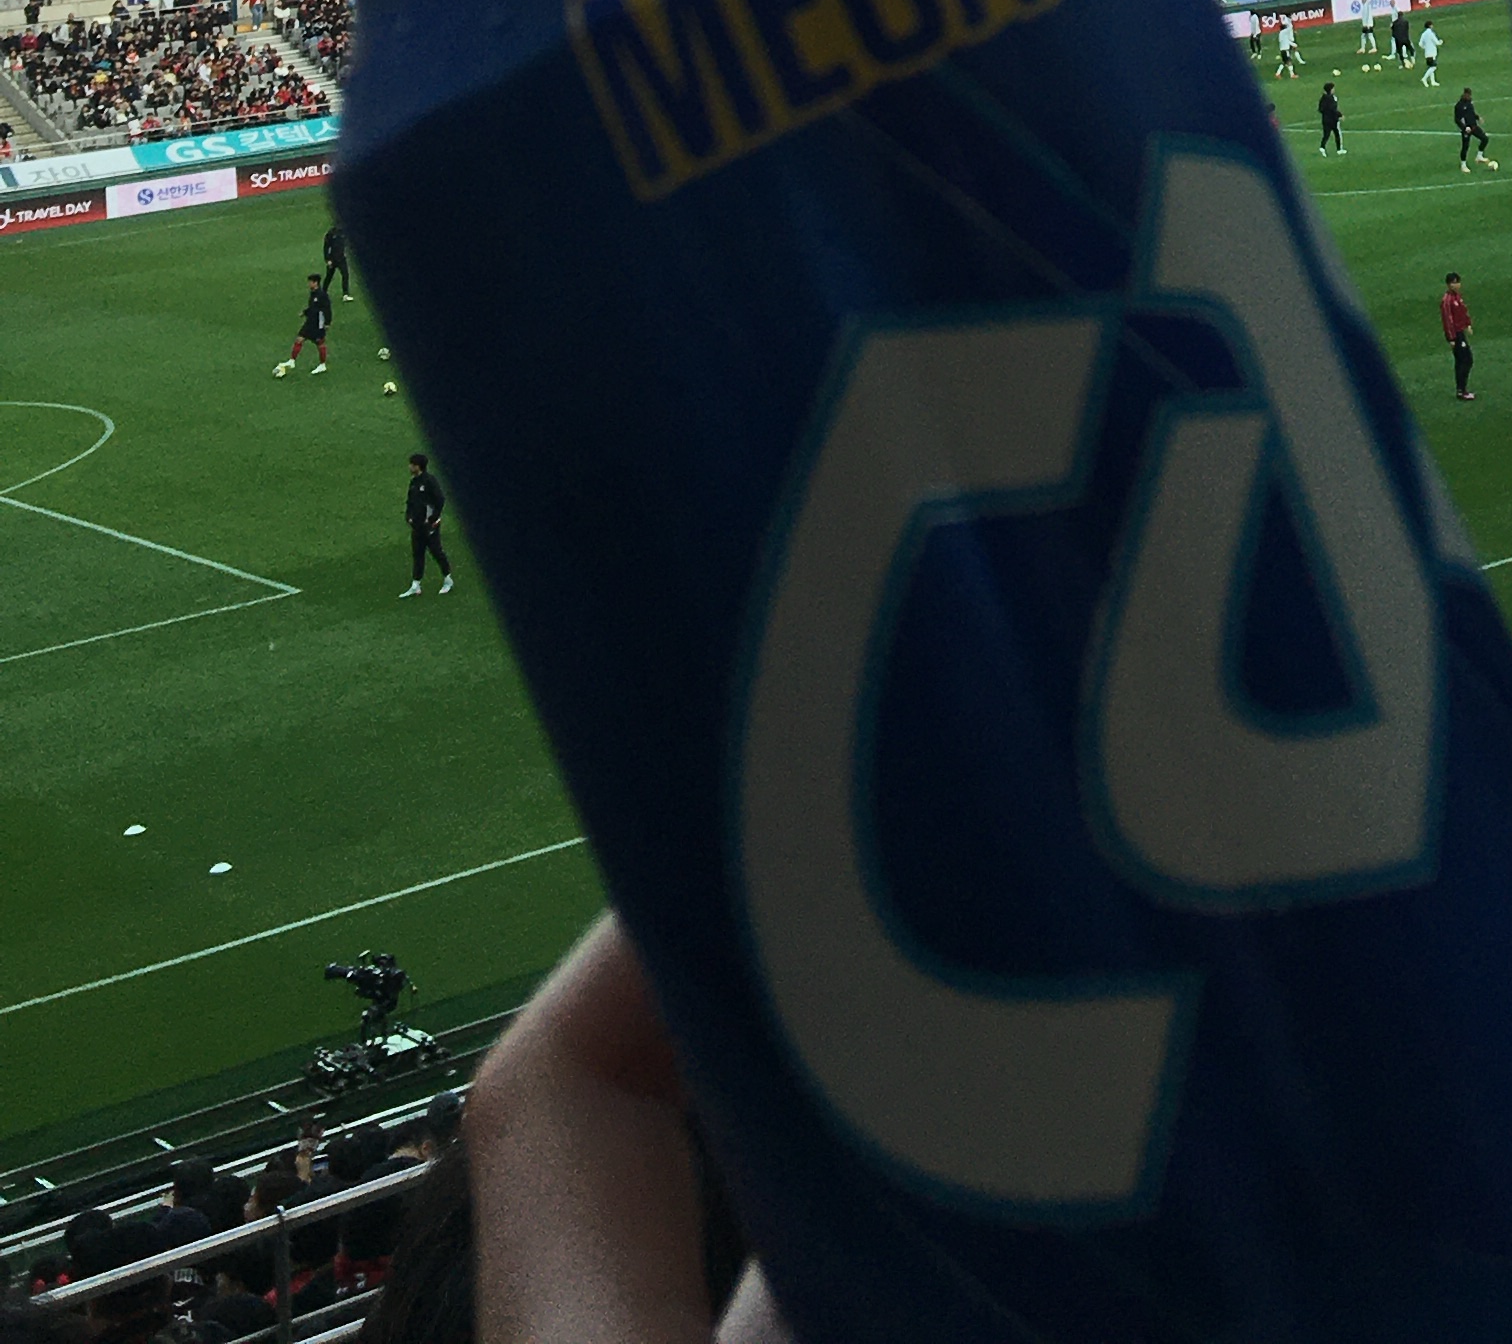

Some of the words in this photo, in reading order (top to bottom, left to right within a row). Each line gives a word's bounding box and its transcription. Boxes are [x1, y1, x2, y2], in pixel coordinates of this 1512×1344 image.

[1262, 12, 1279, 28] SOL
[1308, 8, 1325, 19] DAY
[166, 136, 236, 163] GS
[28, 163, 92, 183] 자이
[250, 168, 278, 188] SOL
[278, 165, 321, 182] TRAVEL
[156, 181, 208, 201] 신한카드
[16, 205, 64, 223] TRAVEL
[66, 200, 92, 216] DAY
